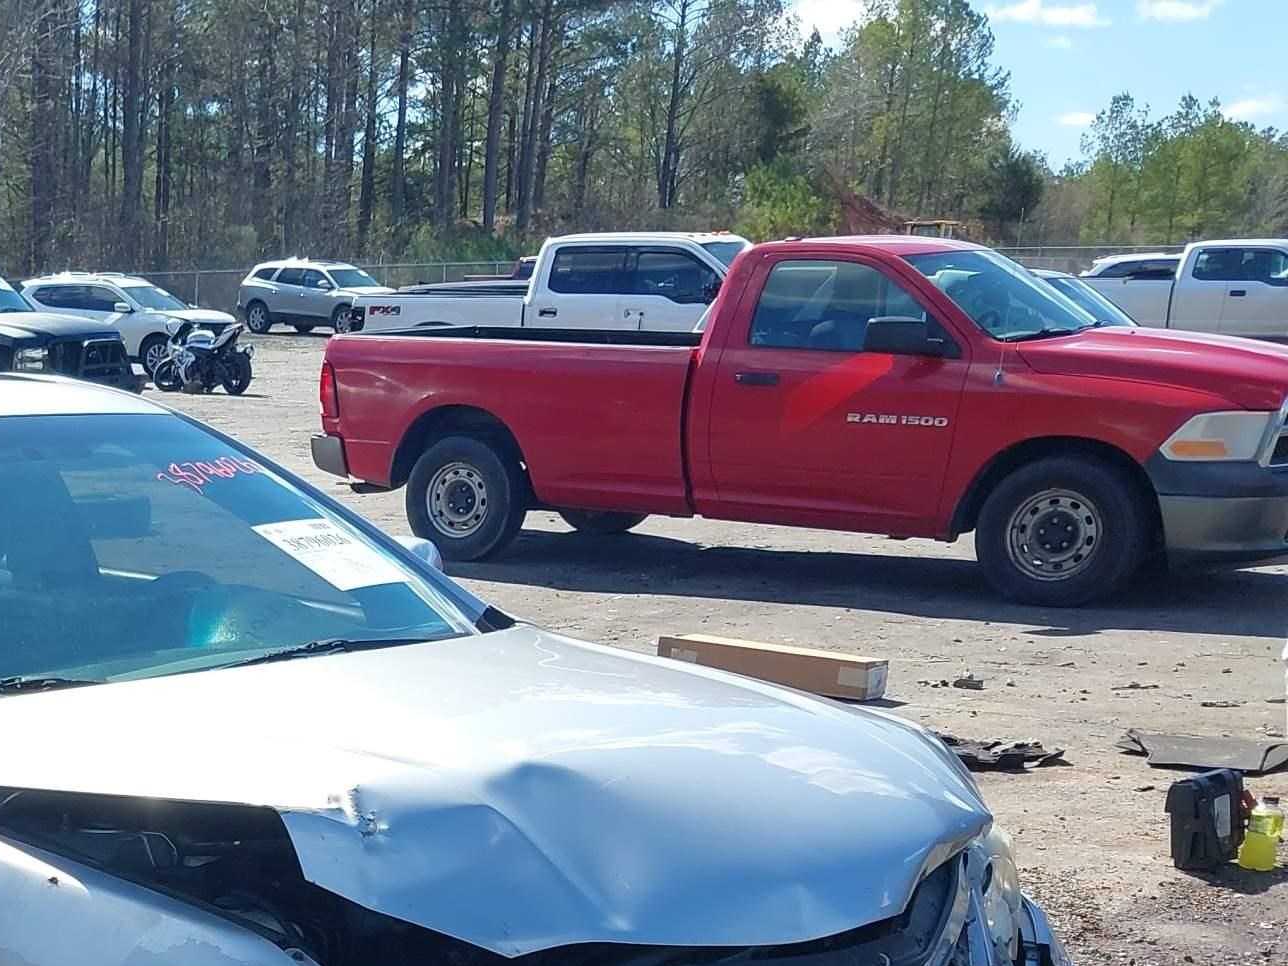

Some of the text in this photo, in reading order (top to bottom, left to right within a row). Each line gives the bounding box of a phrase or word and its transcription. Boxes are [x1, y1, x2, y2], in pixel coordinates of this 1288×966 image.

[369, 305, 401, 316] FX4
[846, 413, 948, 427] RAM 1500
